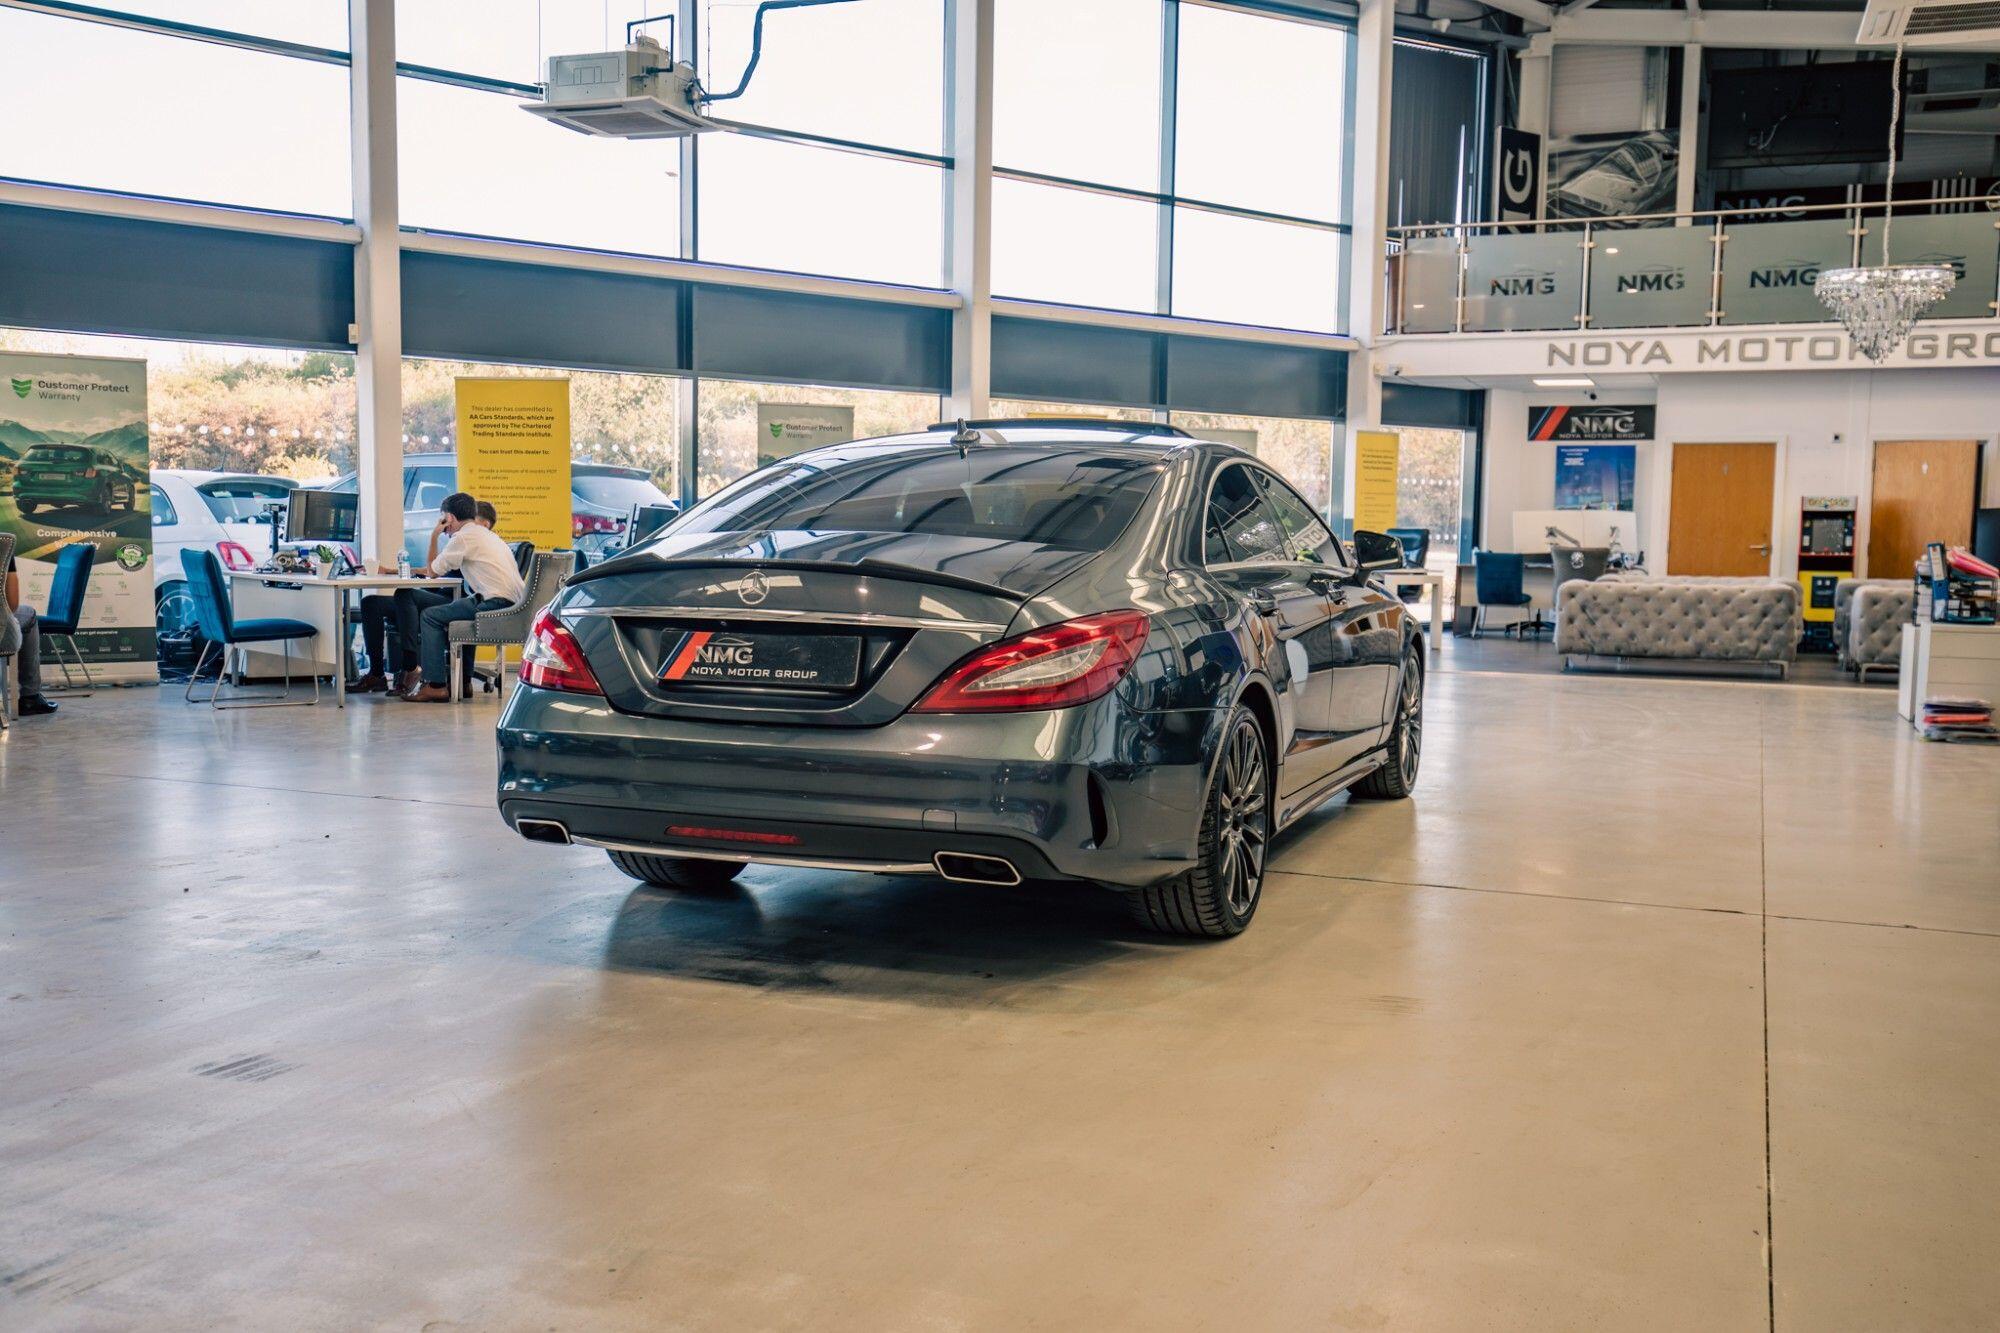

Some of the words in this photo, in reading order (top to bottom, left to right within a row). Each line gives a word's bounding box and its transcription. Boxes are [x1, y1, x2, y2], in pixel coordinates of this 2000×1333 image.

[1490, 277, 1556, 296] NMG
[1617, 272, 1686, 293] NMG
[1749, 267, 1820, 289] NMG
[1547, 340, 1672, 367] NOYA
[38, 380, 88, 391] Customer
[91, 383, 130, 393] Protect
[38, 392, 81, 402] Warranty
[785, 423, 817, 431] Customer
[819, 424, 843, 432] Protect
[1570, 416, 1635, 433] NMG
[36, 528, 117, 539] Comprehensive
[694, 645, 754, 664] NMG
[690, 666, 723, 676] NOYA
[727, 667, 770, 678] MOTOR
[774, 669, 818, 679] GROUP
